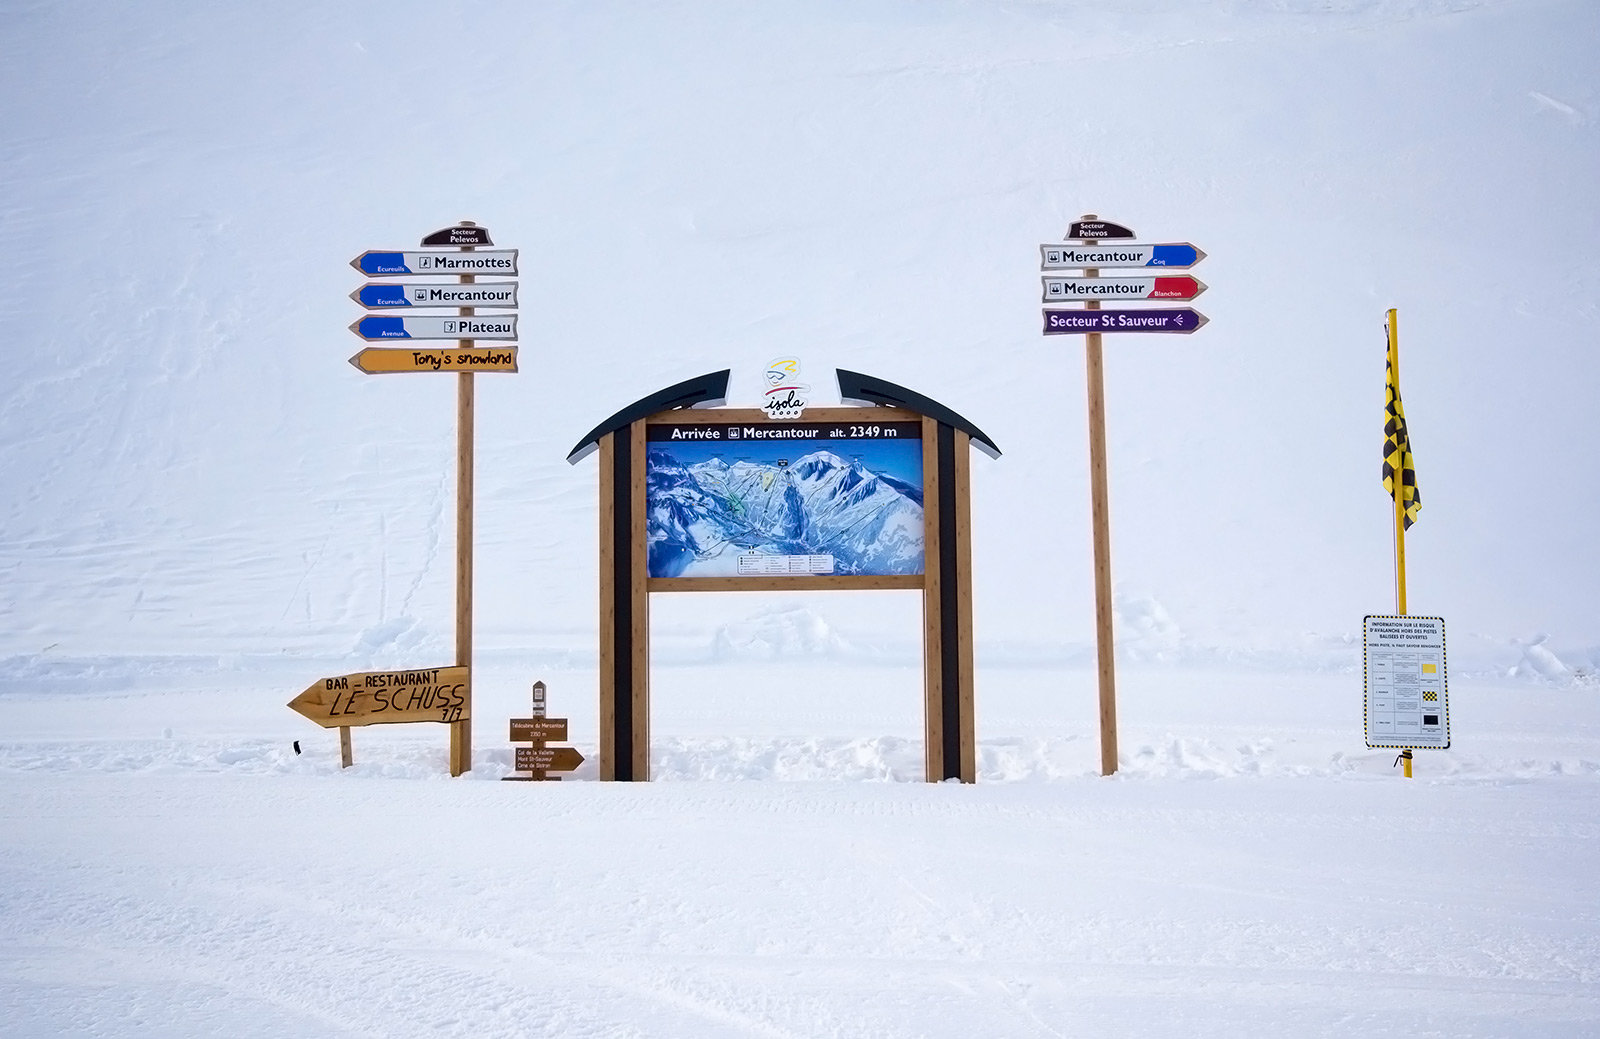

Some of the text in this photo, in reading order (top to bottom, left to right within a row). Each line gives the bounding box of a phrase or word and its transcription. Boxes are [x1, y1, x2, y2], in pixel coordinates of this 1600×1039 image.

[435, 257, 511, 268] Marmottes
[1063, 251, 1143, 262] Mercantour
[1065, 283, 1145, 294] Mercantour
[430, 289, 512, 301] Mercantour
[459, 321, 511, 333] Plateau
[1050, 315, 1168, 327] Secteur St Sauveur
[412, 351, 512, 370] Tony's snowland
[765, 390, 804, 410] isola
[671, 426, 897, 439] Arrivée Mercantour alt. 2349 m
[326, 677, 349, 690] BAR
[366, 670, 439, 688] RESTAURANT
[330, 684, 465, 716] LE SCHUSS
[442, 707, 463, 721] 7/7
